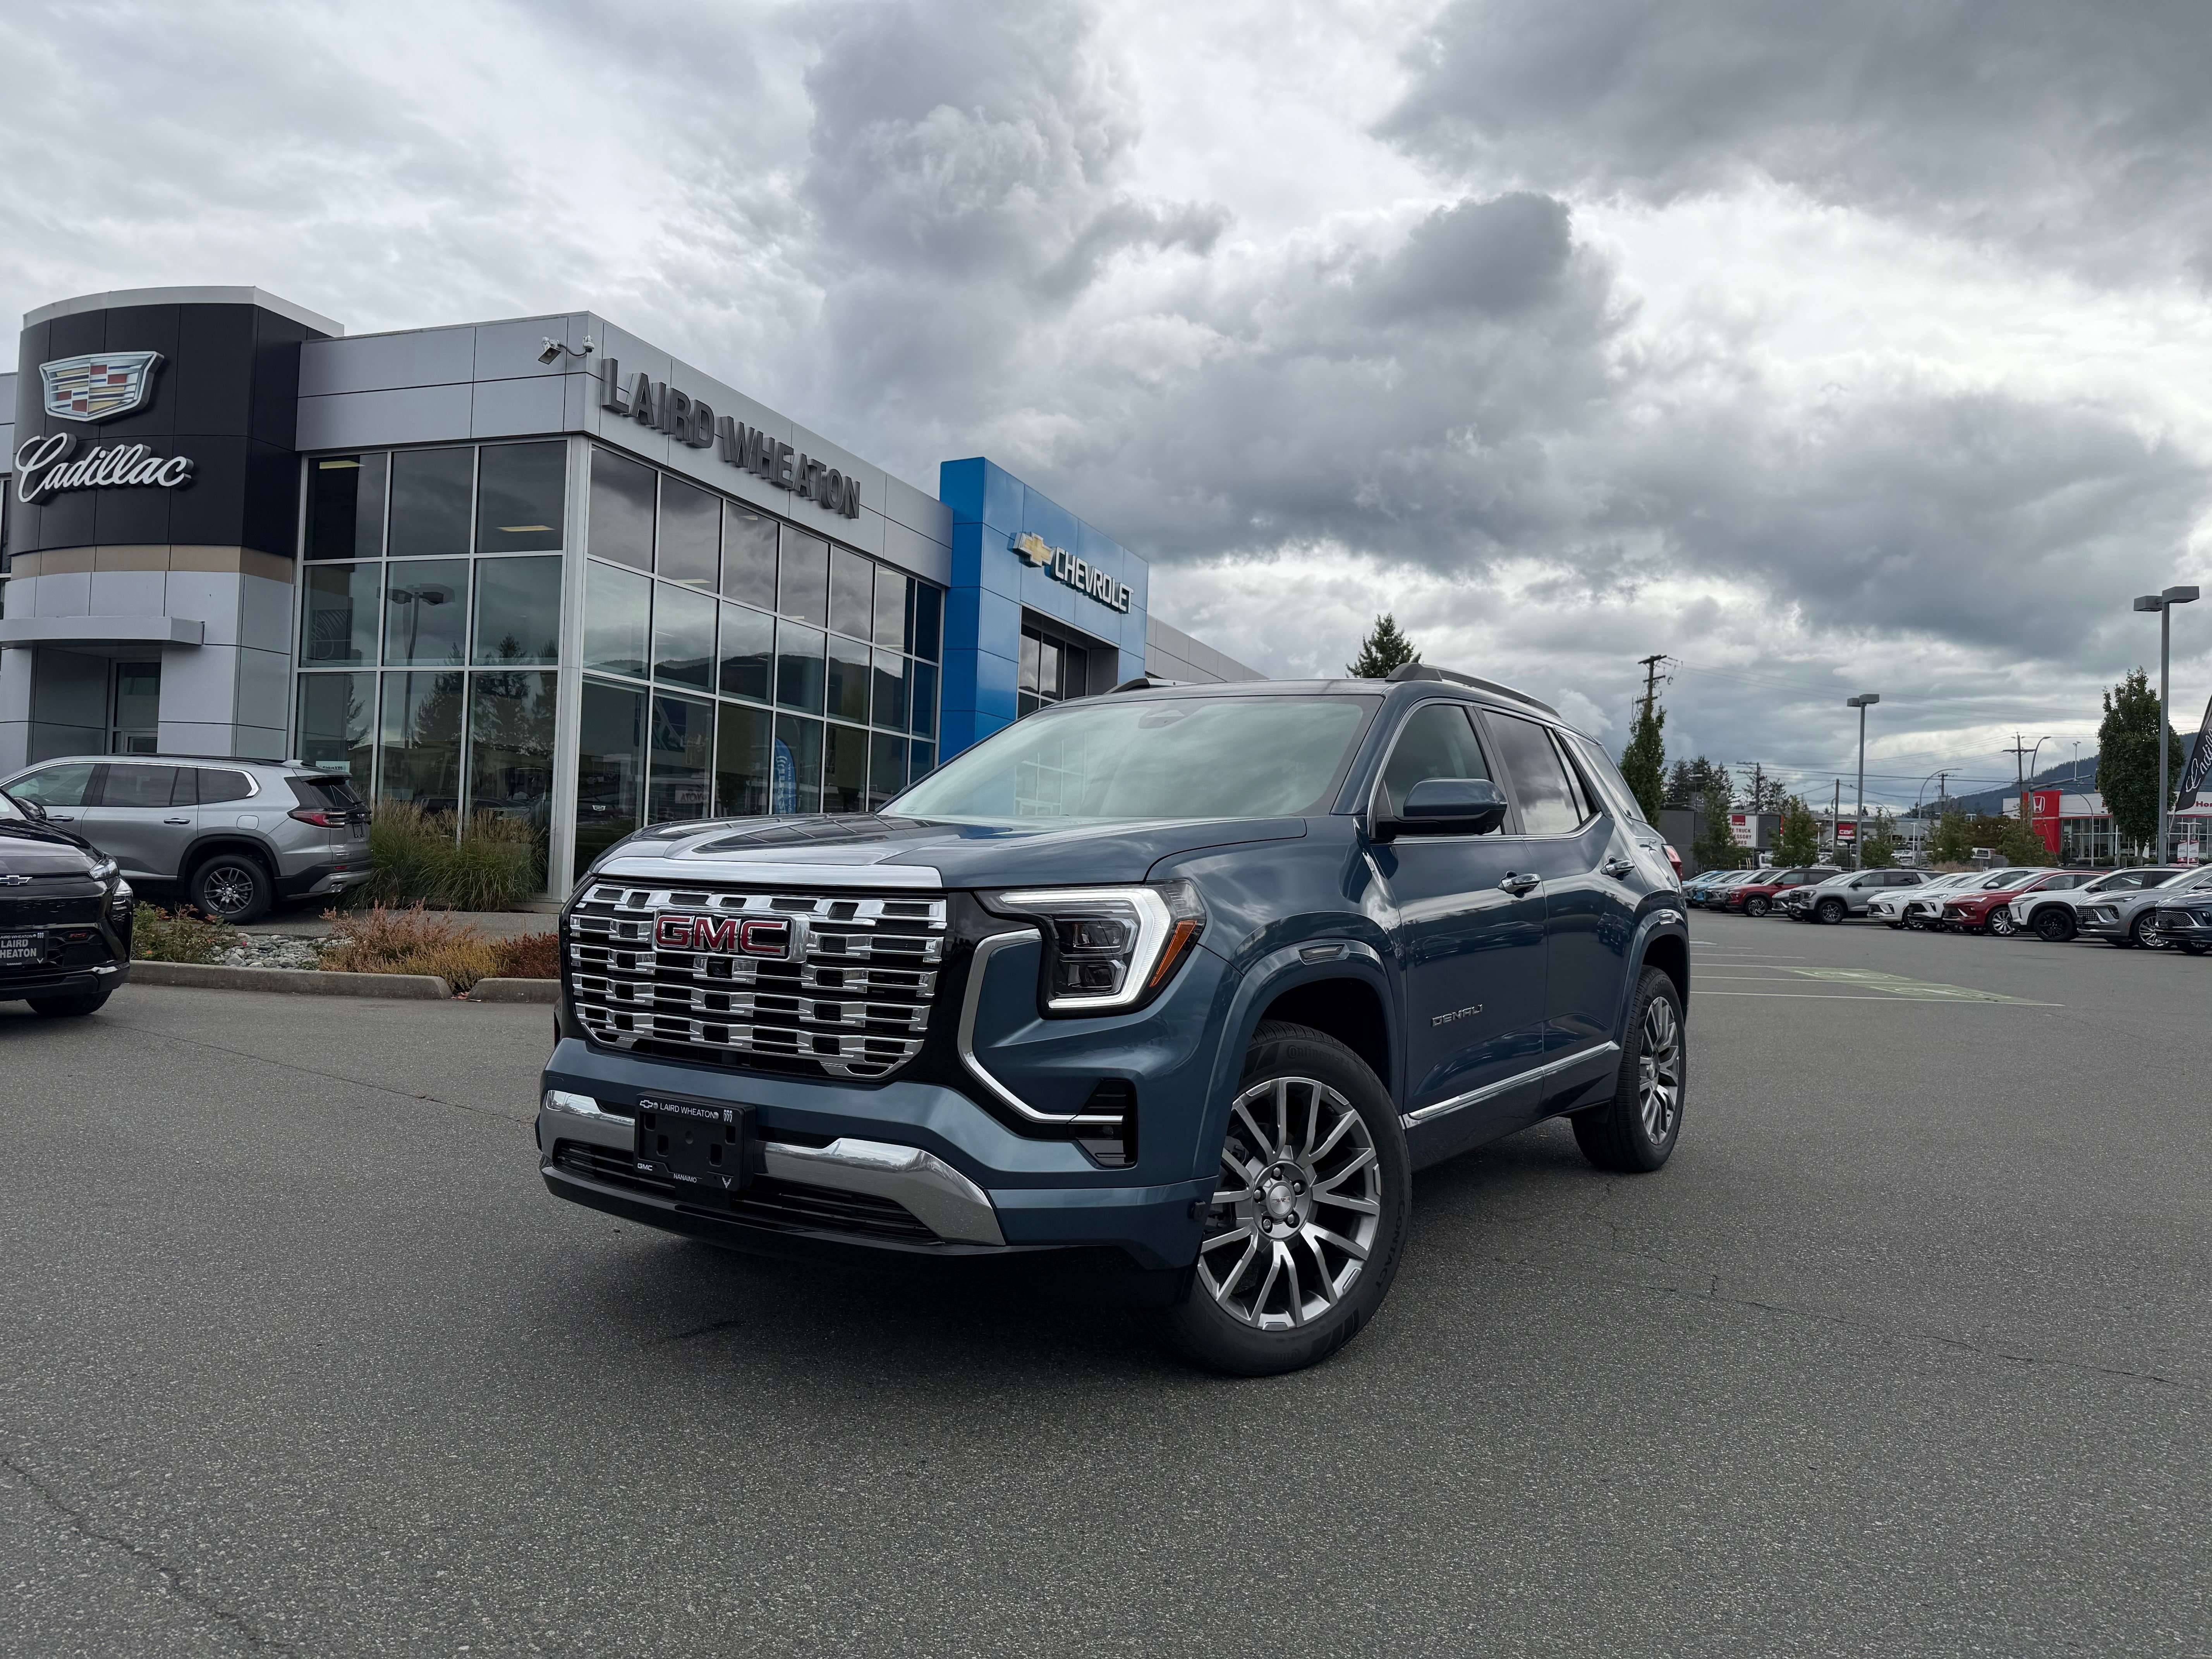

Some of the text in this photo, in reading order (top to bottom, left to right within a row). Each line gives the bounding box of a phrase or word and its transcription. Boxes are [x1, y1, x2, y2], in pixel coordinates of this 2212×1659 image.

[602, 358, 860, 519] LAIRD WHEATON
[15, 432, 191, 503] Cadillac
[1055, 546, 1134, 614] CHEVROLET
[1, 939, 29, 948] LAIRD
[656, 915, 788, 956] GMC
[0, 948, 37, 958] HEATON
[1432, 1004, 1483, 1027] DENALI
[660, 1103, 715, 1119] LAIRD WHEATON
[637, 1163, 653, 1171] GMC
[673, 1173, 697, 1183] NANAIMO
